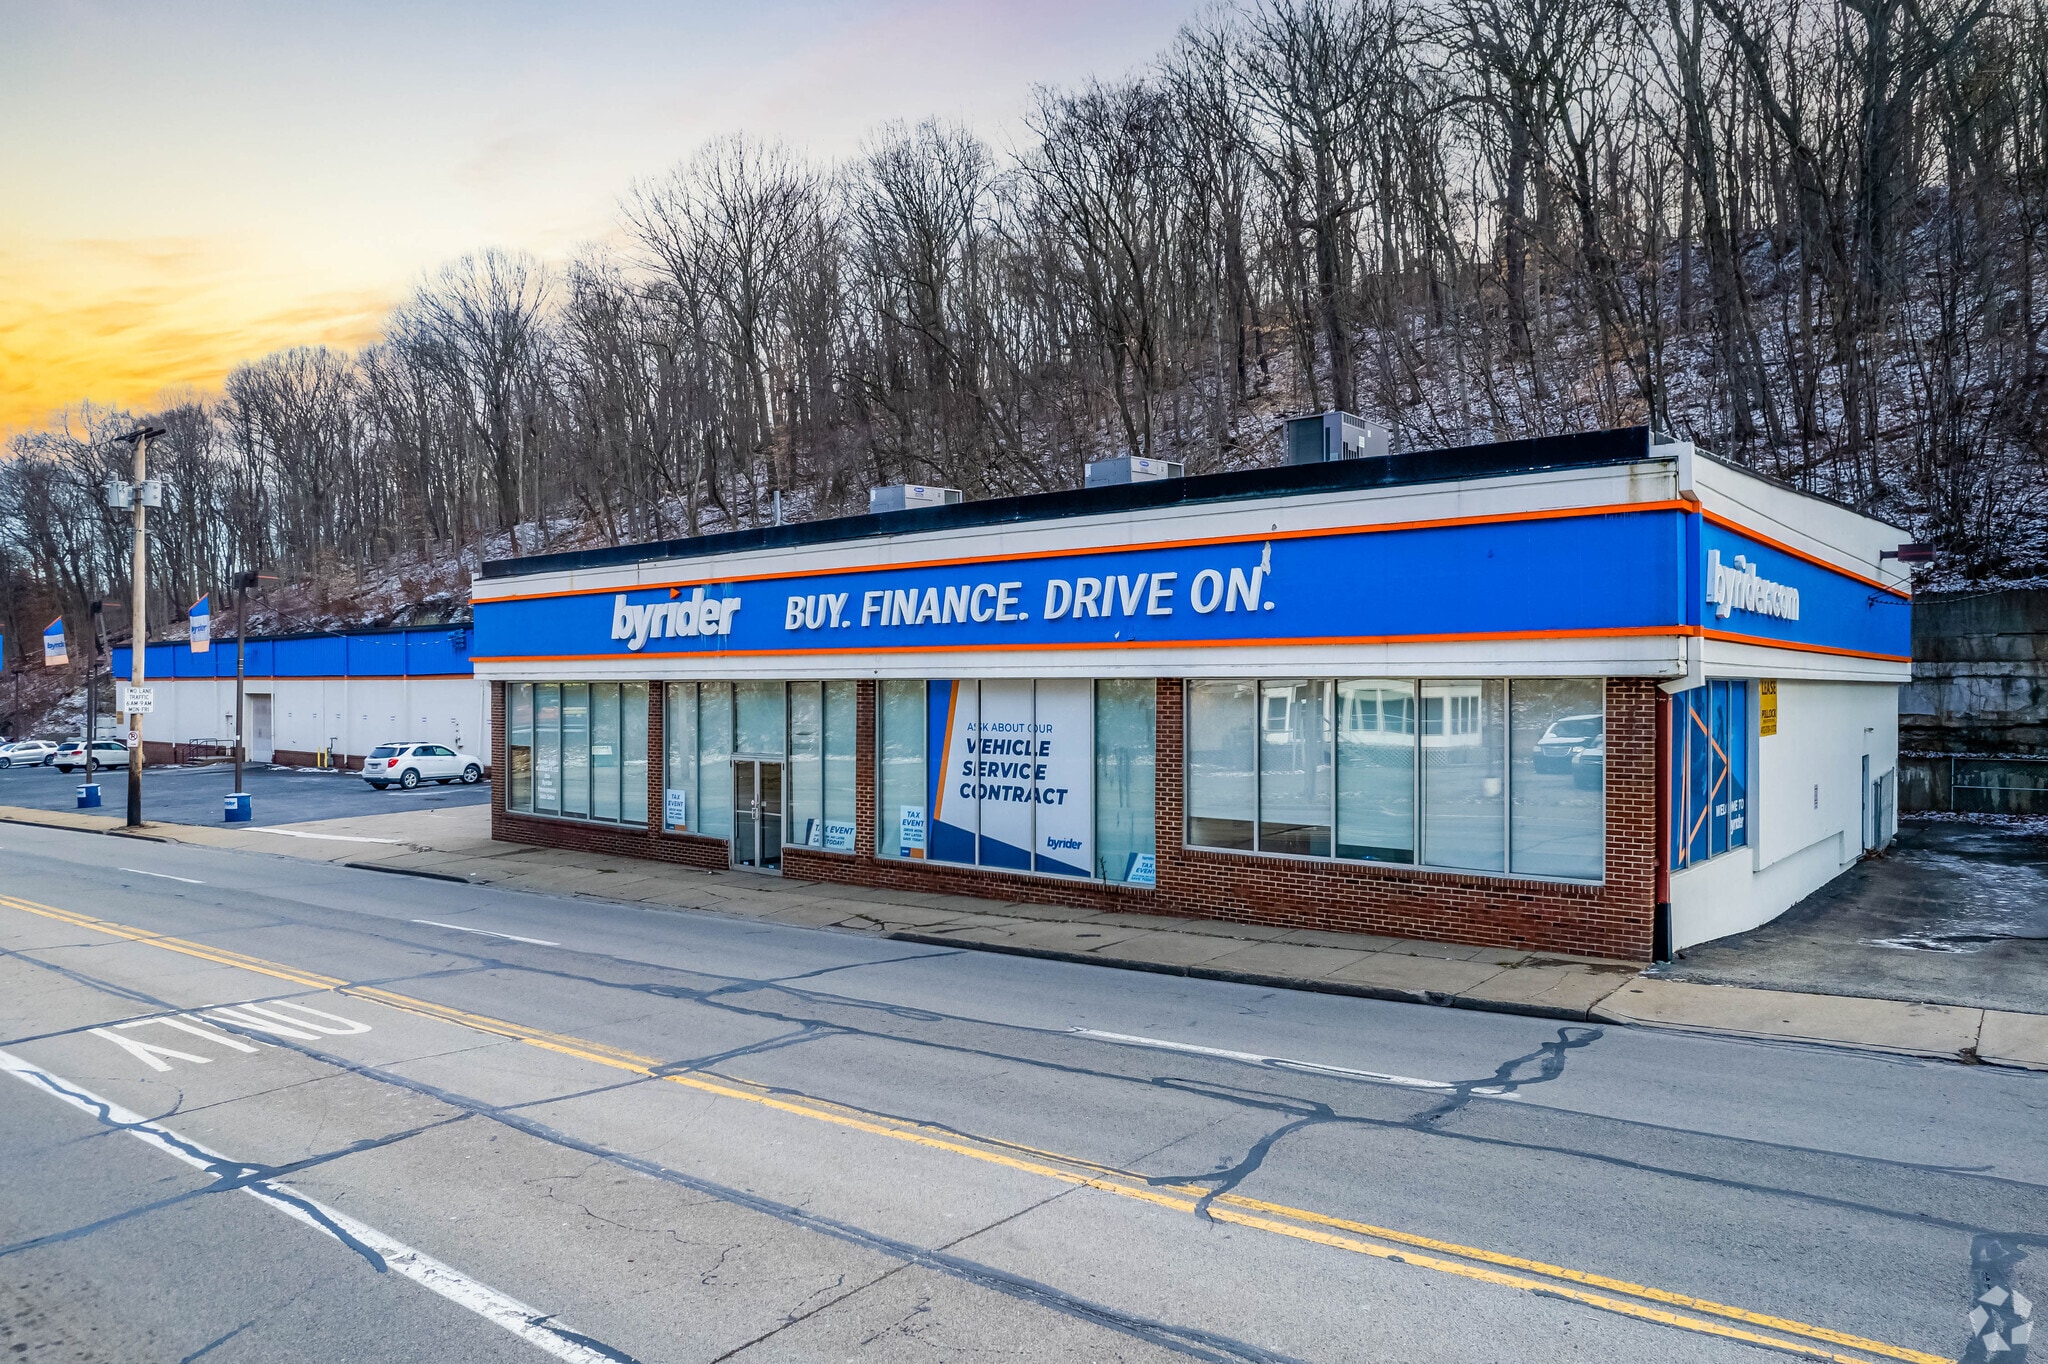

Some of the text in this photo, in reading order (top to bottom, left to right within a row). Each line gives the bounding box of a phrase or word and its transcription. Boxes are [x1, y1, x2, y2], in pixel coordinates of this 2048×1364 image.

[1706, 549, 1800, 621] byrider.com
[785, 565, 1275, 630] BUY. FINANCE. DRIVE ON.
[611, 587, 741, 651] byrider
[1762, 680, 1776, 695] LEASE
[967, 722, 1053, 734] ASK ABOUT OUR
[966, 738, 1051, 757] VEHICLE
[962, 760, 1047, 781] SERVICE
[959, 783, 1069, 805] CONTRACT
[907, 810, 921, 818] TAX
[830, 825, 855, 835] EVENT
[902, 819, 924, 827] EVENT
[826, 839, 845, 847] TODAY!
[1047, 836, 1083, 850] byrider
[87, 1000, 373, 1072] ONLY
